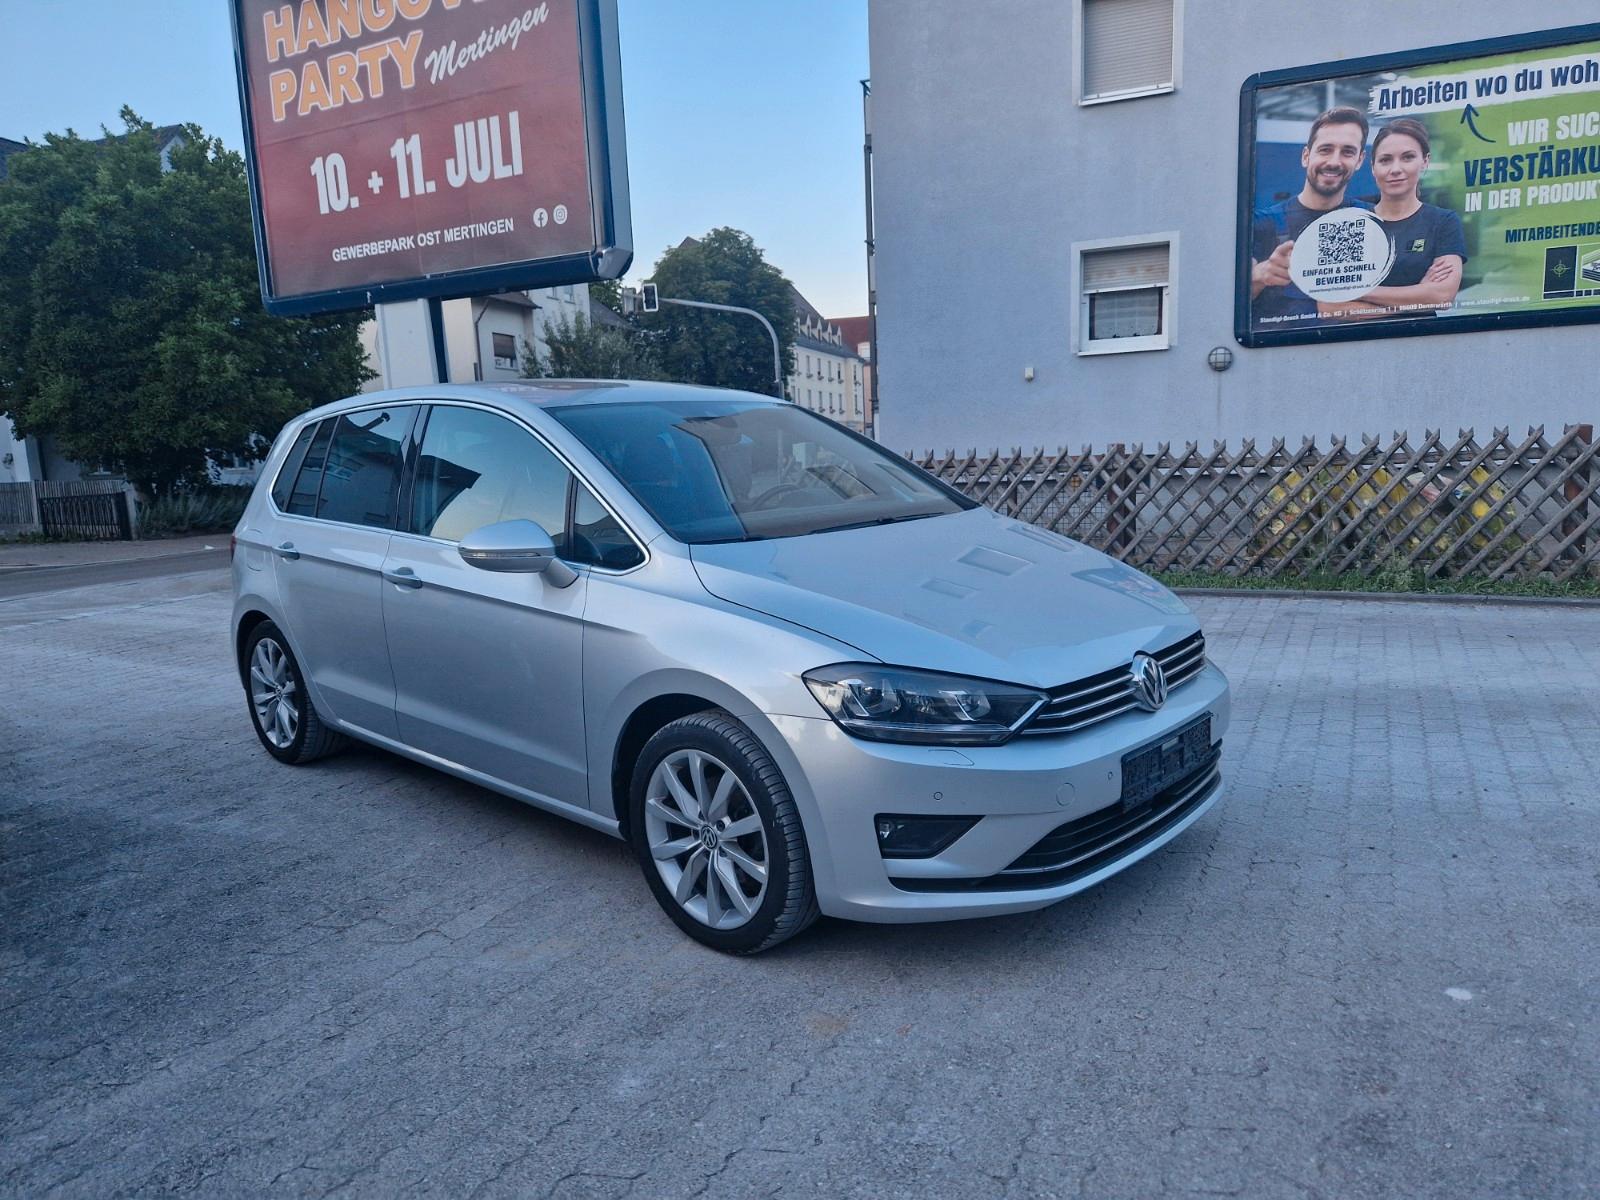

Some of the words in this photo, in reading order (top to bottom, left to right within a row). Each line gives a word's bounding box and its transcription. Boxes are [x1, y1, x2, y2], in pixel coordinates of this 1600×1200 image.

[269, 30, 424, 122] PARTY
[424, 2, 550, 84] Mertingen
[1378, 80, 1468, 111] Arbeiten
[1475, 75, 1507, 98] wo
[1515, 69, 1543, 93] du
[1507, 118, 1549, 146] WIR
[1555, 111, 1600, 140] SUC
[310, 152, 360, 214] 10.
[367, 170, 384, 194] +
[390, 133, 437, 199] 11.
[445, 110, 523, 188] JULI
[1465, 191, 1482, 212] IN
[1488, 188, 1521, 210] DER
[1527, 179, 1600, 206] PRODUK
[332, 235, 415, 263] GEWERBEPARK
[417, 230, 441, 247] OST
[444, 218, 514, 243] MERTINGEN
[1302, 267, 1333, 277] EINFACH
[1343, 263, 1376, 273] SCHNELL
[1315, 274, 1362, 286] BEWERBEN
